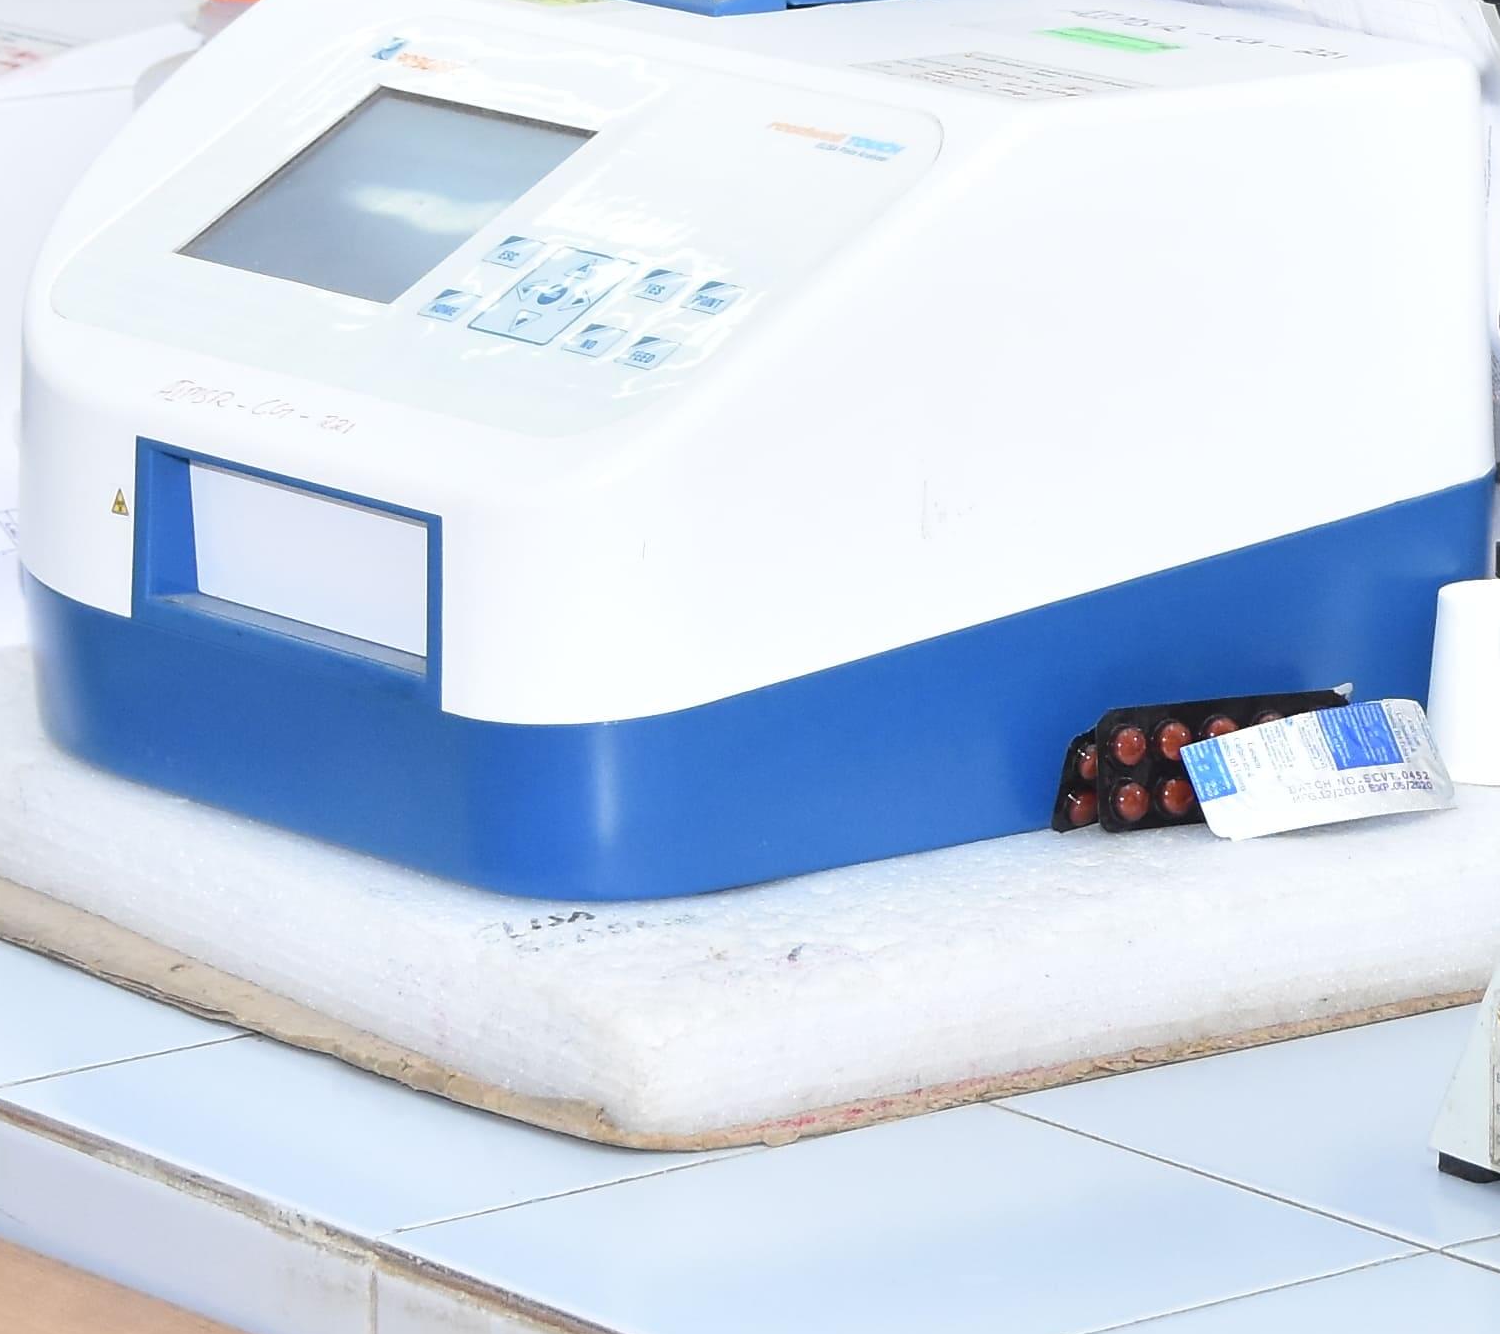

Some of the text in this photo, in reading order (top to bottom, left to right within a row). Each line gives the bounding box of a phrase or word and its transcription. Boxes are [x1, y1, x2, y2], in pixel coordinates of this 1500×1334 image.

[498, 250, 520, 262] ESC
[645, 283, 665, 296] YES
[430, 302, 458, 317] HOME
[580, 338, 598, 350] NO
[630, 349, 656, 364] FEED
